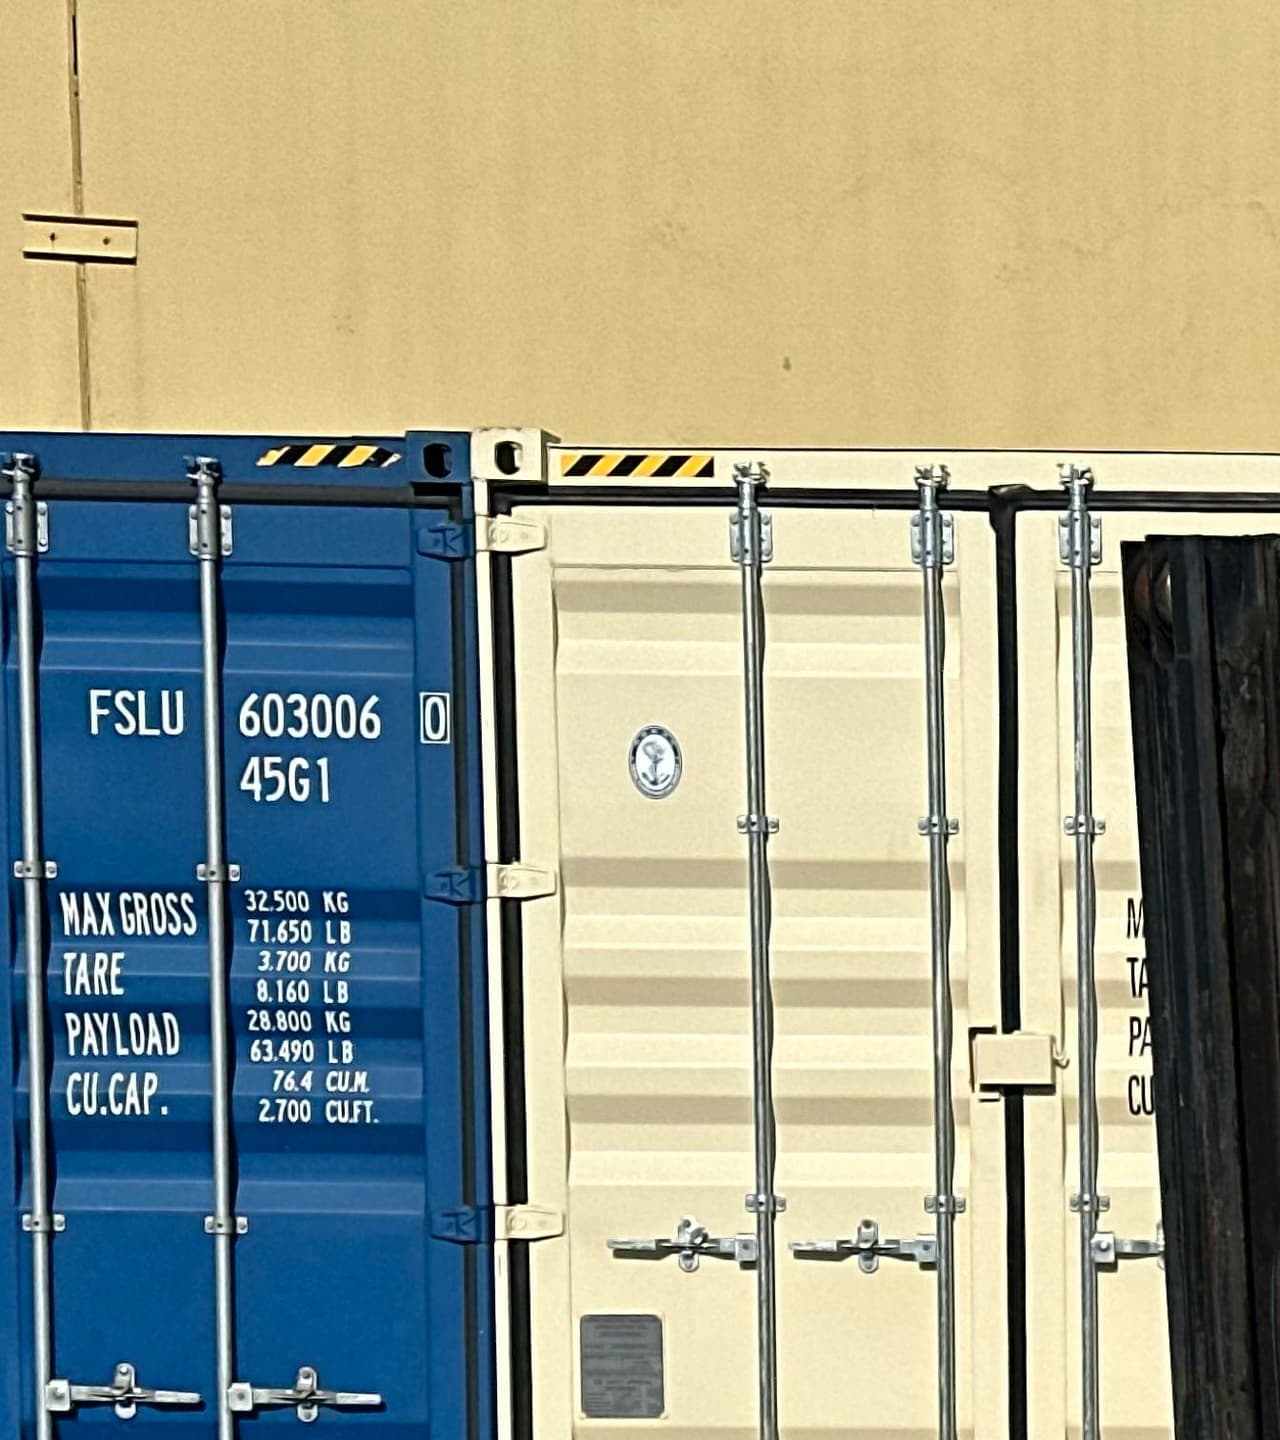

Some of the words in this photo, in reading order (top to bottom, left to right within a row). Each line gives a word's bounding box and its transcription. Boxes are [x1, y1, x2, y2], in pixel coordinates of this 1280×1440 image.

[89, 689, 185, 737] FSLU
[239, 692, 382, 740] 603006
[424, 695, 447, 741] 0
[240, 755, 330, 803] 45G1
[59, 891, 116, 937] MAX
[119, 891, 198, 937] GROSS
[244, 889, 310, 913] 32.500
[322, 890, 350, 913] KG
[247, 918, 312, 944] 71.650
[325, 919, 352, 944] LB
[63, 952, 125, 996] TARE
[257, 951, 312, 972] 3.700
[323, 951, 351, 972] KG
[256, 979, 310, 1004] 8.160
[323, 979, 350, 1003] LB
[247, 1009, 312, 1032] 28.800
[324, 1010, 352, 1032] KG
[64, 1012, 181, 1057] PAYLOAD
[250, 1038, 315, 1063] 63.490
[327, 1039, 354, 1064] LB
[272, 1069, 313, 1092] 76.4
[258, 1098, 312, 1123] 2.700
